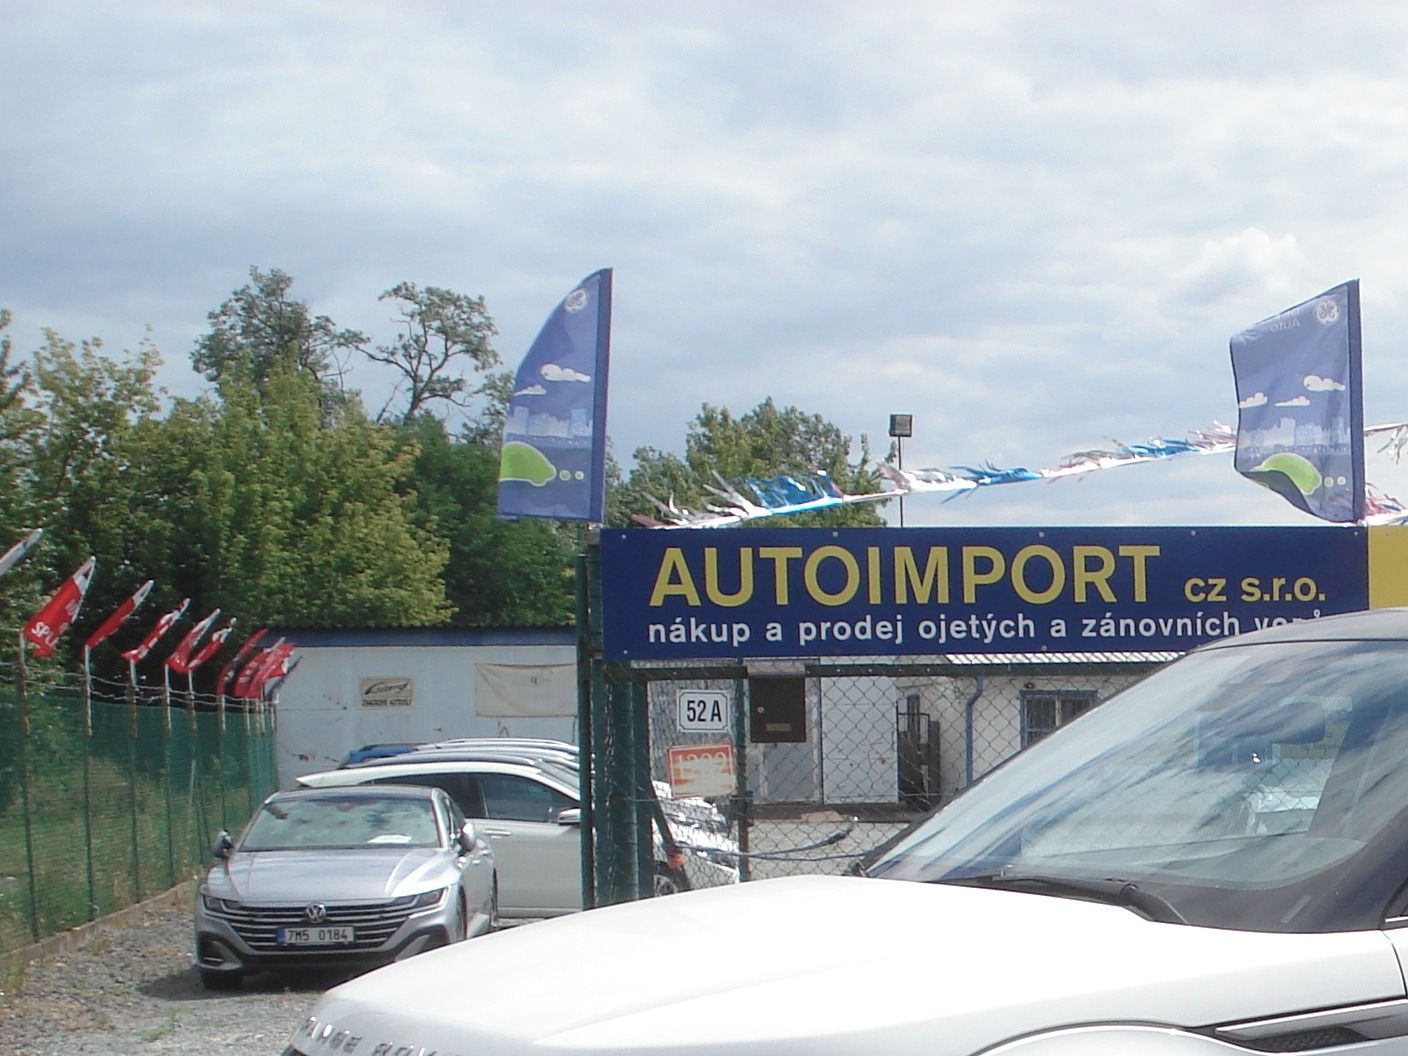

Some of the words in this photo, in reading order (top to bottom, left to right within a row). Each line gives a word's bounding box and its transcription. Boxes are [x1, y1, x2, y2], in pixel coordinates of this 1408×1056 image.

[648, 544, 1161, 606] AUTOIMPORT
[1184, 576, 1228, 602] cz
[1240, 576, 1326, 602] s.r.o.
[648, 615, 751, 647] nákup
[765, 622, 782, 642] a
[799, 615, 905, 646] prodej
[917, 612, 1035, 642] ojetých
[1049, 618, 1068, 636] a
[1081, 612, 1240, 638] zánovních
[686, 699, 707, 723] 52
[709, 699, 723, 723] A
[318, 929, 348, 941] 0184
